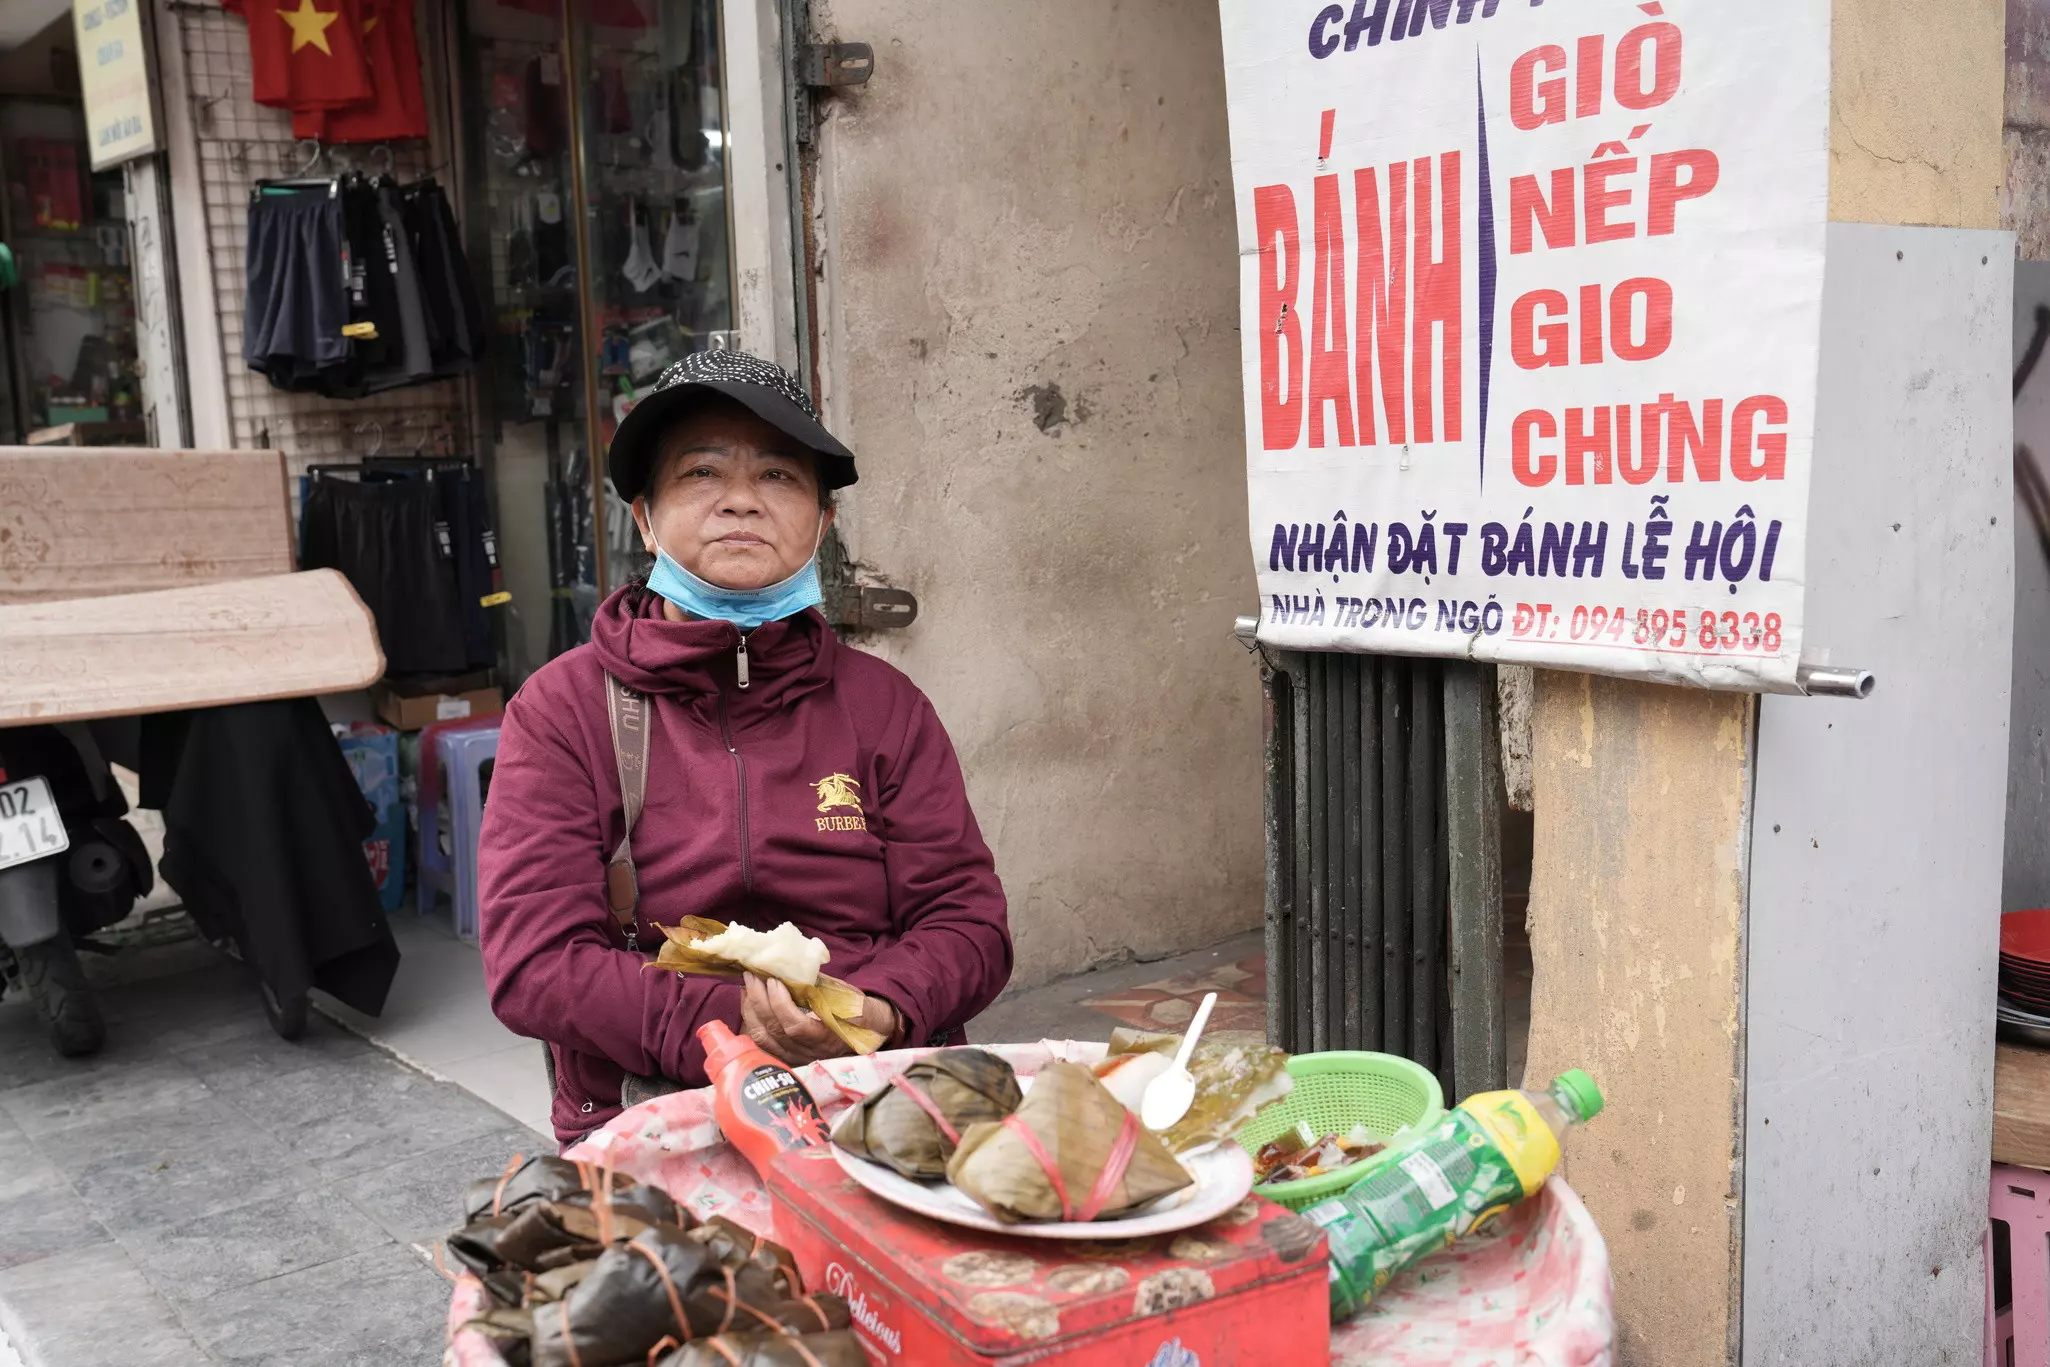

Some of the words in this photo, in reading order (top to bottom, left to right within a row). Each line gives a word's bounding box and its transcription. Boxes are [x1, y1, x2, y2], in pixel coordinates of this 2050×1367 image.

[1509, 1, 1683, 132] GIÒ
[1509, 123, 1720, 256] NẾP
[1253, 108, 1462, 451] BÁNH
[1510, 276, 1674, 371] GIO
[1511, 392, 1789, 488] CHƯNG
[1269, 509, 1379, 584] NHẬN
[1386, 509, 1469, 586] ĐẶT
[1480, 505, 1609, 578] BÁNH
[1621, 494, 1674, 581] LỄ
[1684, 503, 1783, 596] HỘI
[1269, 587, 1326, 625] NHÀ
[1332, 596, 1428, 631] TRONG
[1434, 593, 1504, 636] NGÕ
[1511, 602, 1561, 640] ĐT:
[1569, 604, 1626, 643] 094
[1698, 610, 1783, 652] 8338
[743, 1071, 796, 1100] CHIN-SU
[825, 1261, 901, 1355] Delicious
